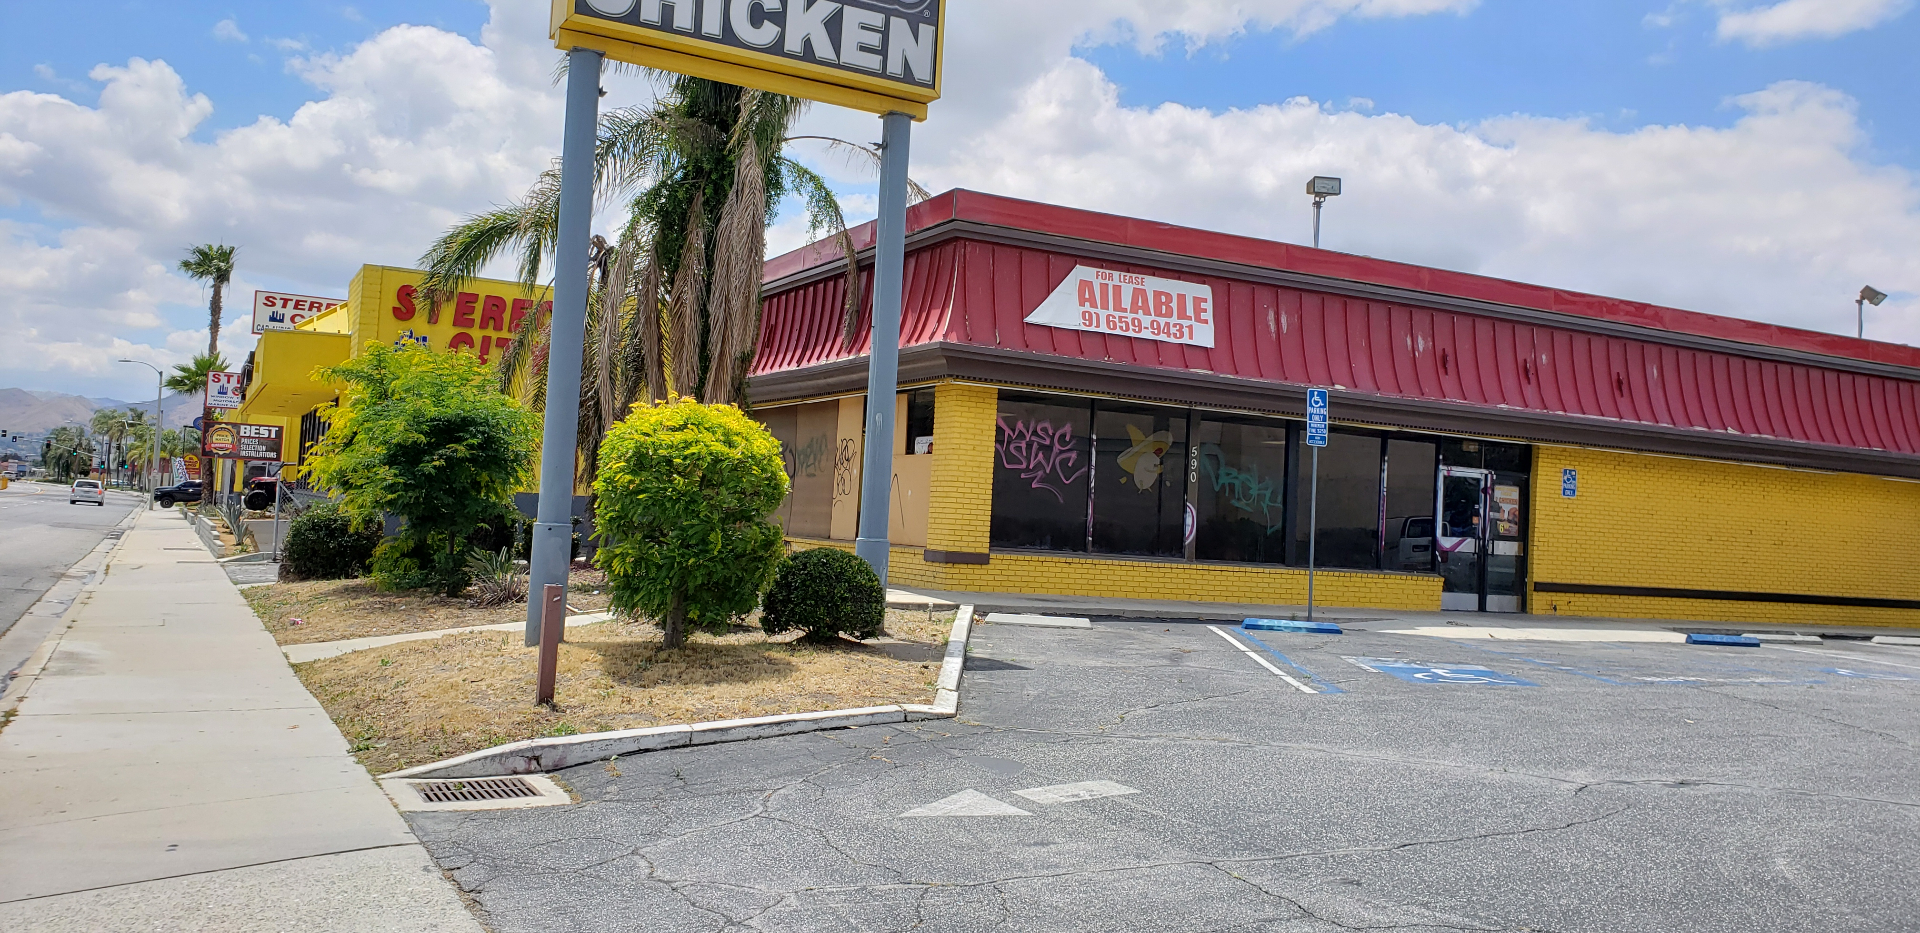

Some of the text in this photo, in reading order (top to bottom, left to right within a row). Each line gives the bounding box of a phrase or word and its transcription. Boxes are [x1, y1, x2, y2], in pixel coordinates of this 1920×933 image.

[1095, 270, 1146, 287] FOR LEASE
[1077, 278, 1209, 325] AILABLE
[1105, 313, 1194, 341] 659-9431
[1309, 407, 1326, 415] PARKING
[240, 425, 279, 438] BEST
[240, 444, 267, 452] SELECTION
[240, 450, 277, 459] INSTALLATIONS
[1190, 446, 1198, 482] 590
